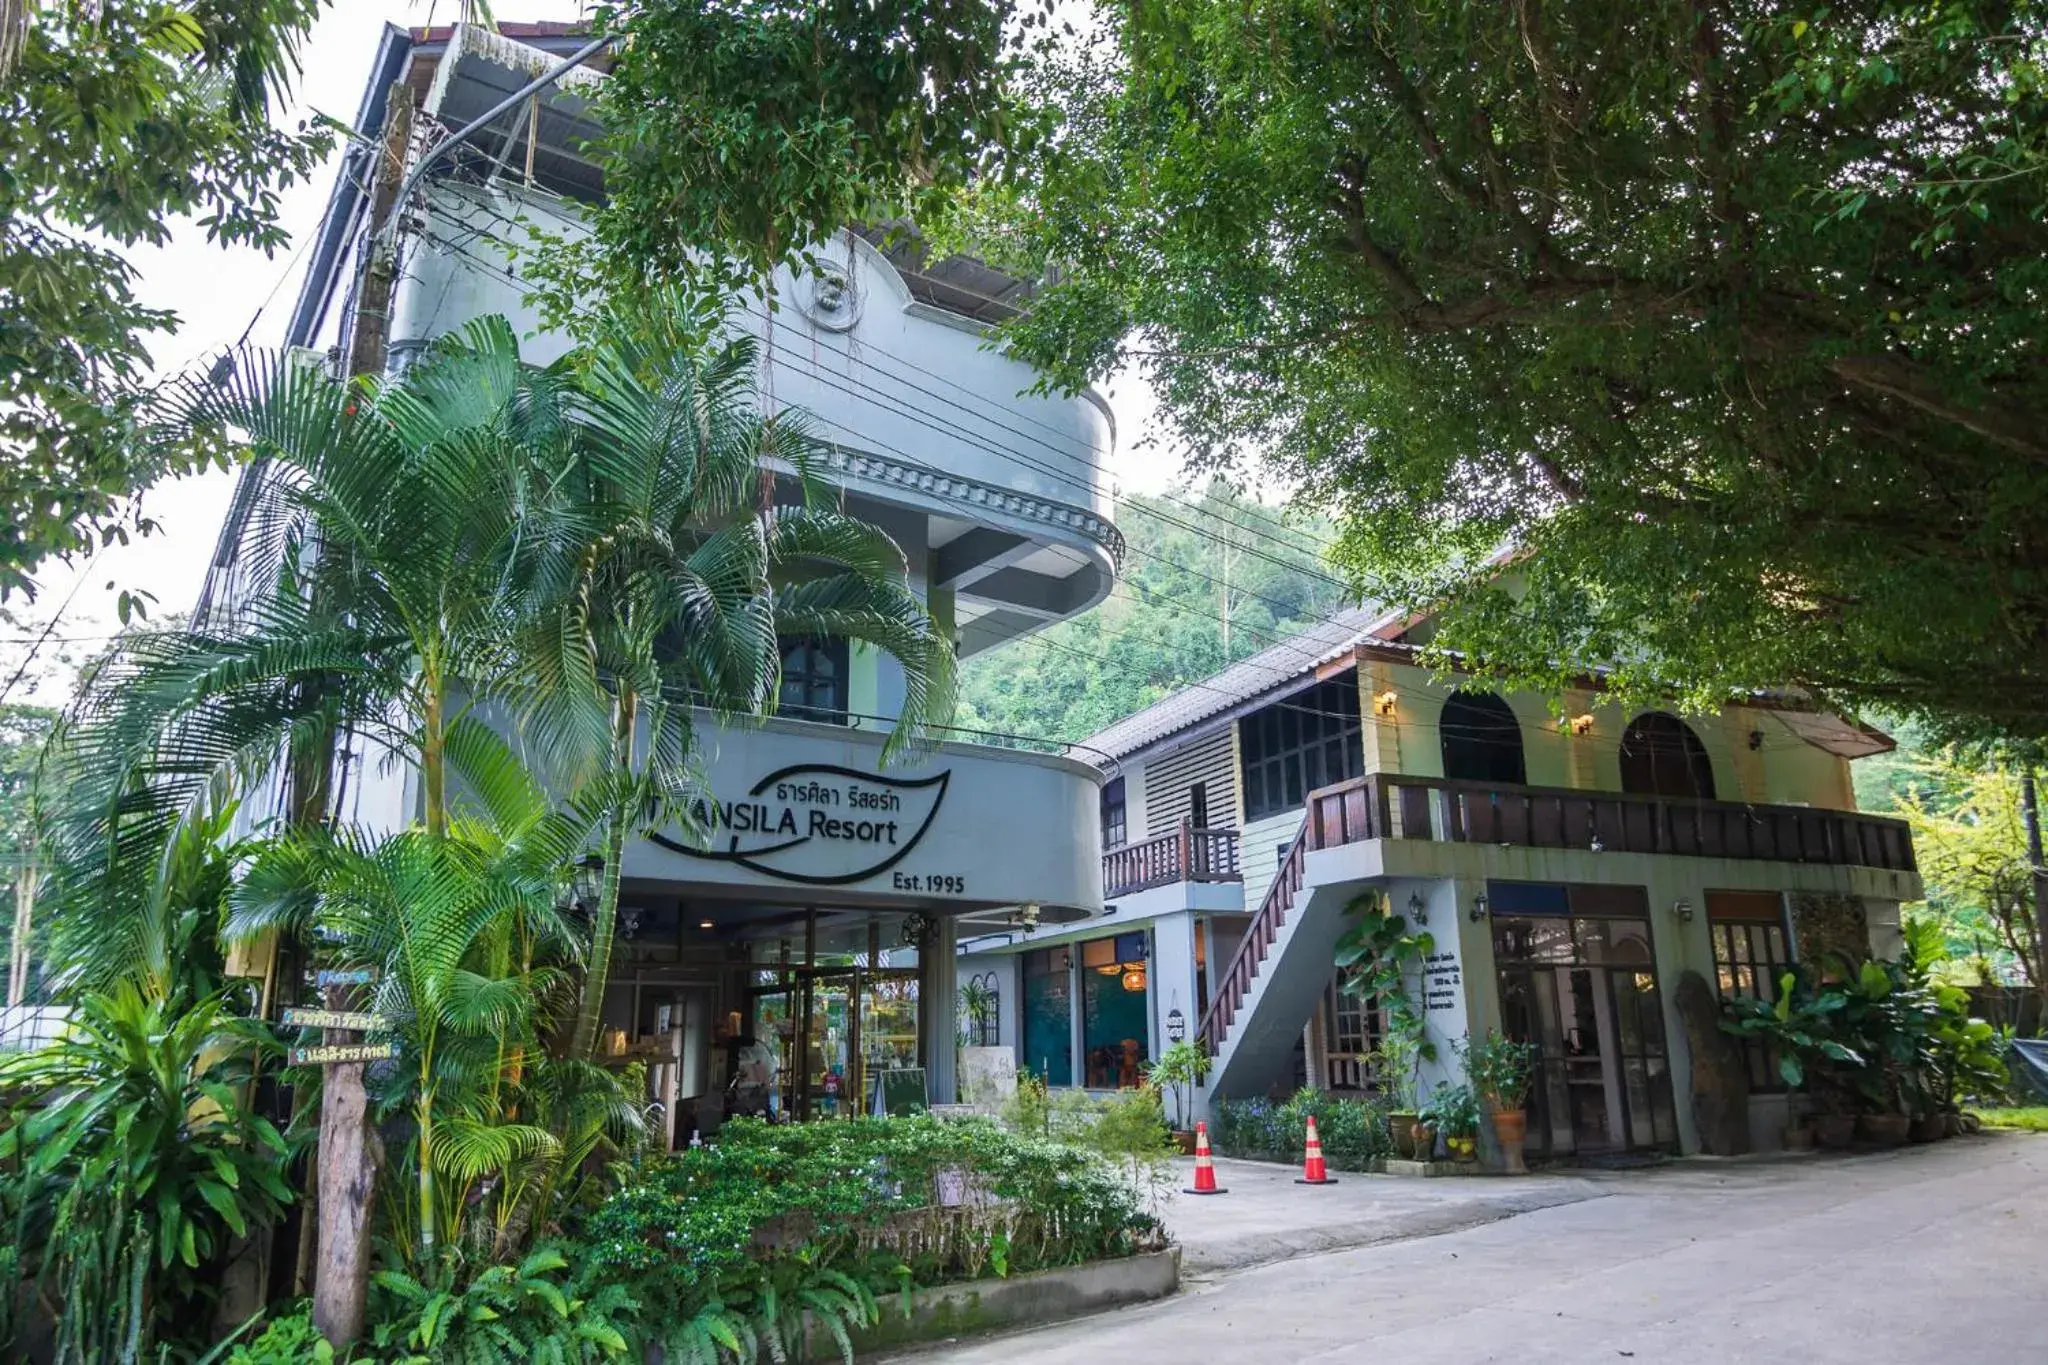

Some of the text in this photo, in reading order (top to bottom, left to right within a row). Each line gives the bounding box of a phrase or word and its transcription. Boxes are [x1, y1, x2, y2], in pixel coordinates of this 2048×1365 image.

[776, 780, 900, 813] ธารศิลา รีสอร์ท
[807, 809, 898, 845] Resort
